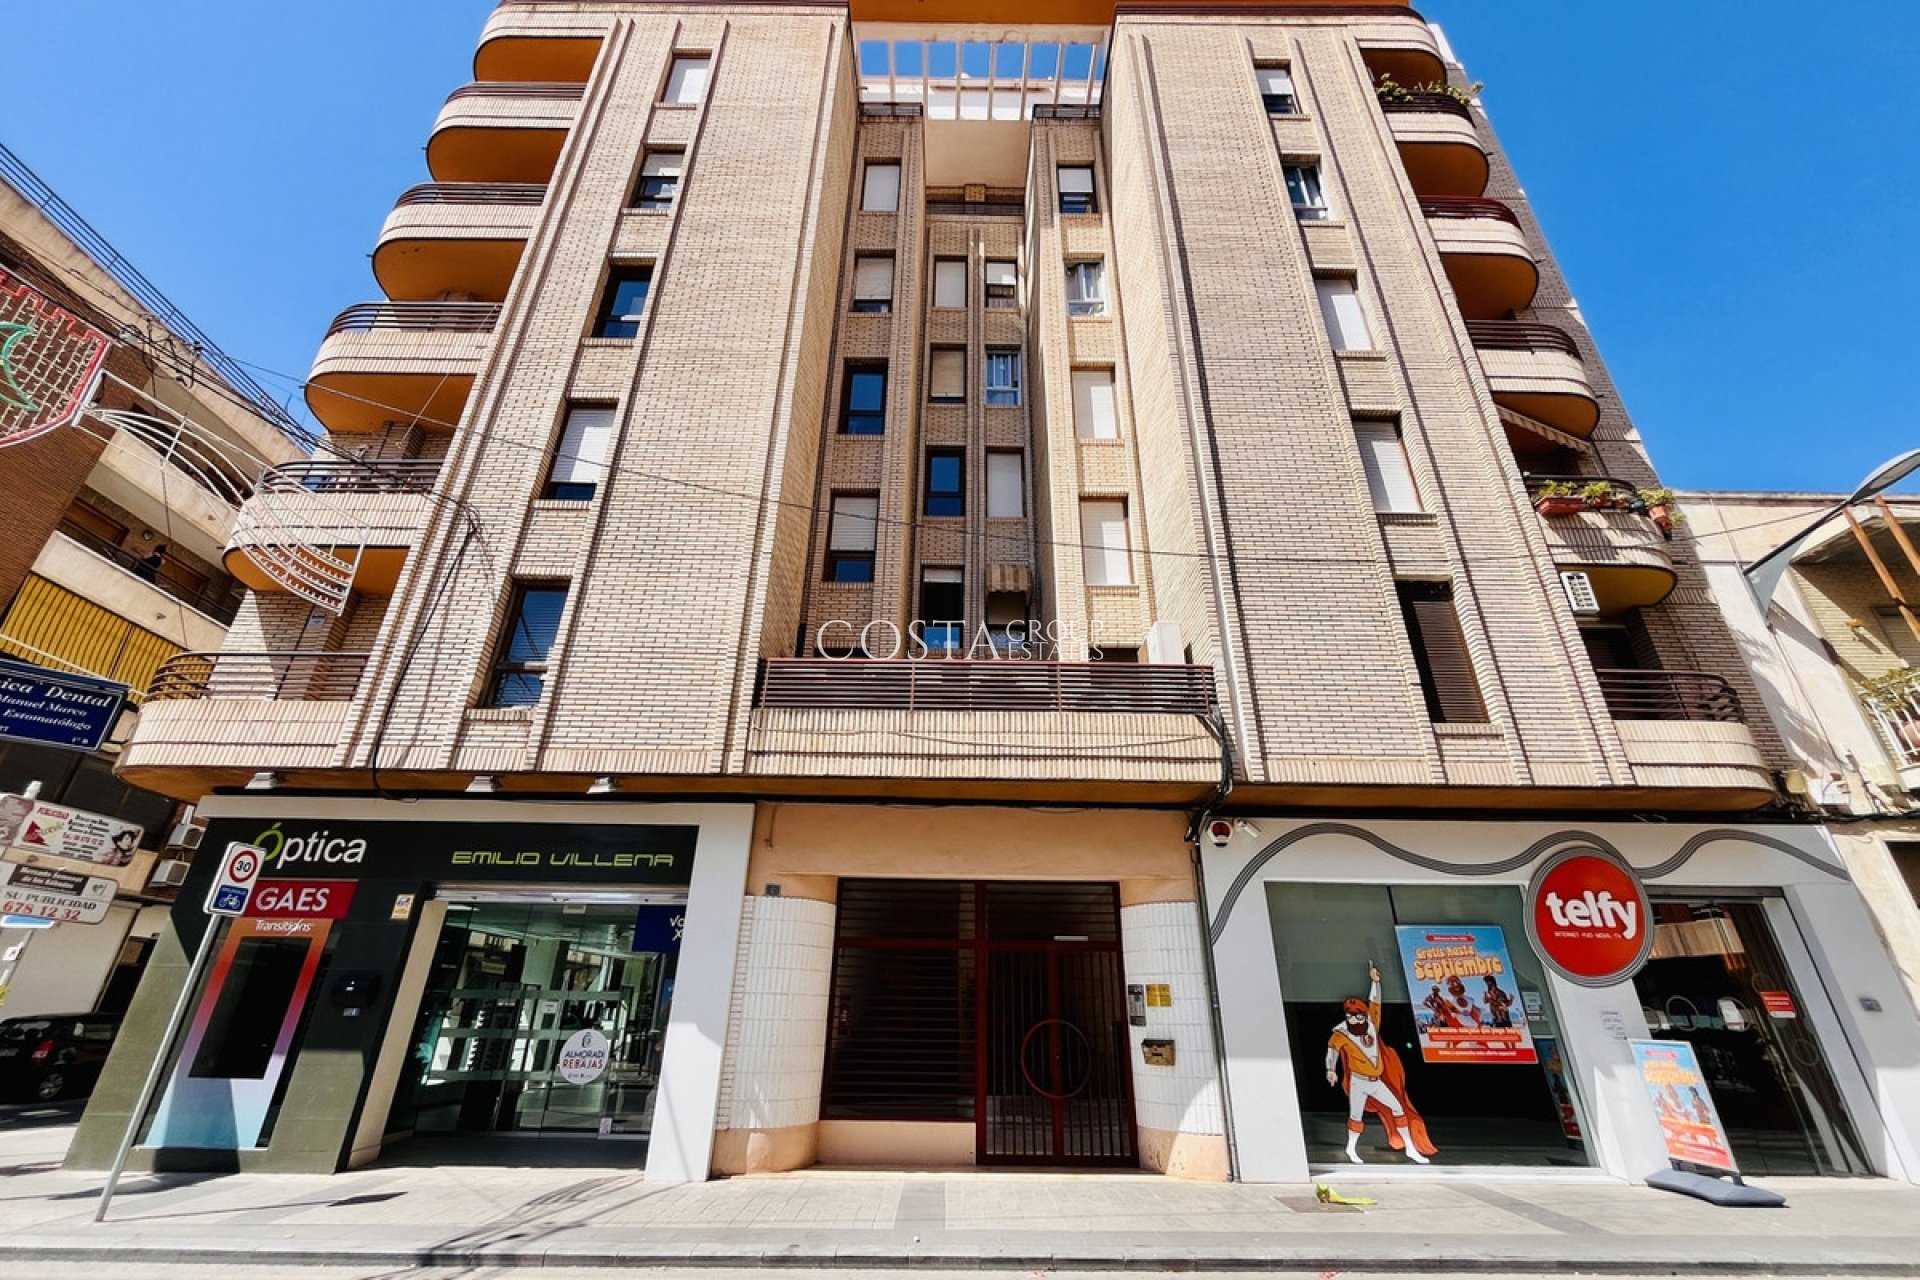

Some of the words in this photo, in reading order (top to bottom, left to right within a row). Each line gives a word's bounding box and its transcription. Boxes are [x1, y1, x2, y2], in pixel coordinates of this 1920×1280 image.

[0, 678, 33, 693] ica
[45, 686, 112, 707] Dental
[253, 822, 367, 869] Óptica
[235, 860, 251, 873] 30
[452, 850, 540, 865] EMILIO
[550, 853, 674, 867] VILLENA
[26, 893, 97, 910] PUBLICIDAD
[255, 887, 330, 911] GAES
[3, 900, 34, 915] 678
[40, 905, 58, 918] 12
[63, 907, 81, 921] 32
[1545, 890, 1637, 939] telfy
[562, 1058, 604, 1070] REBAJAS
